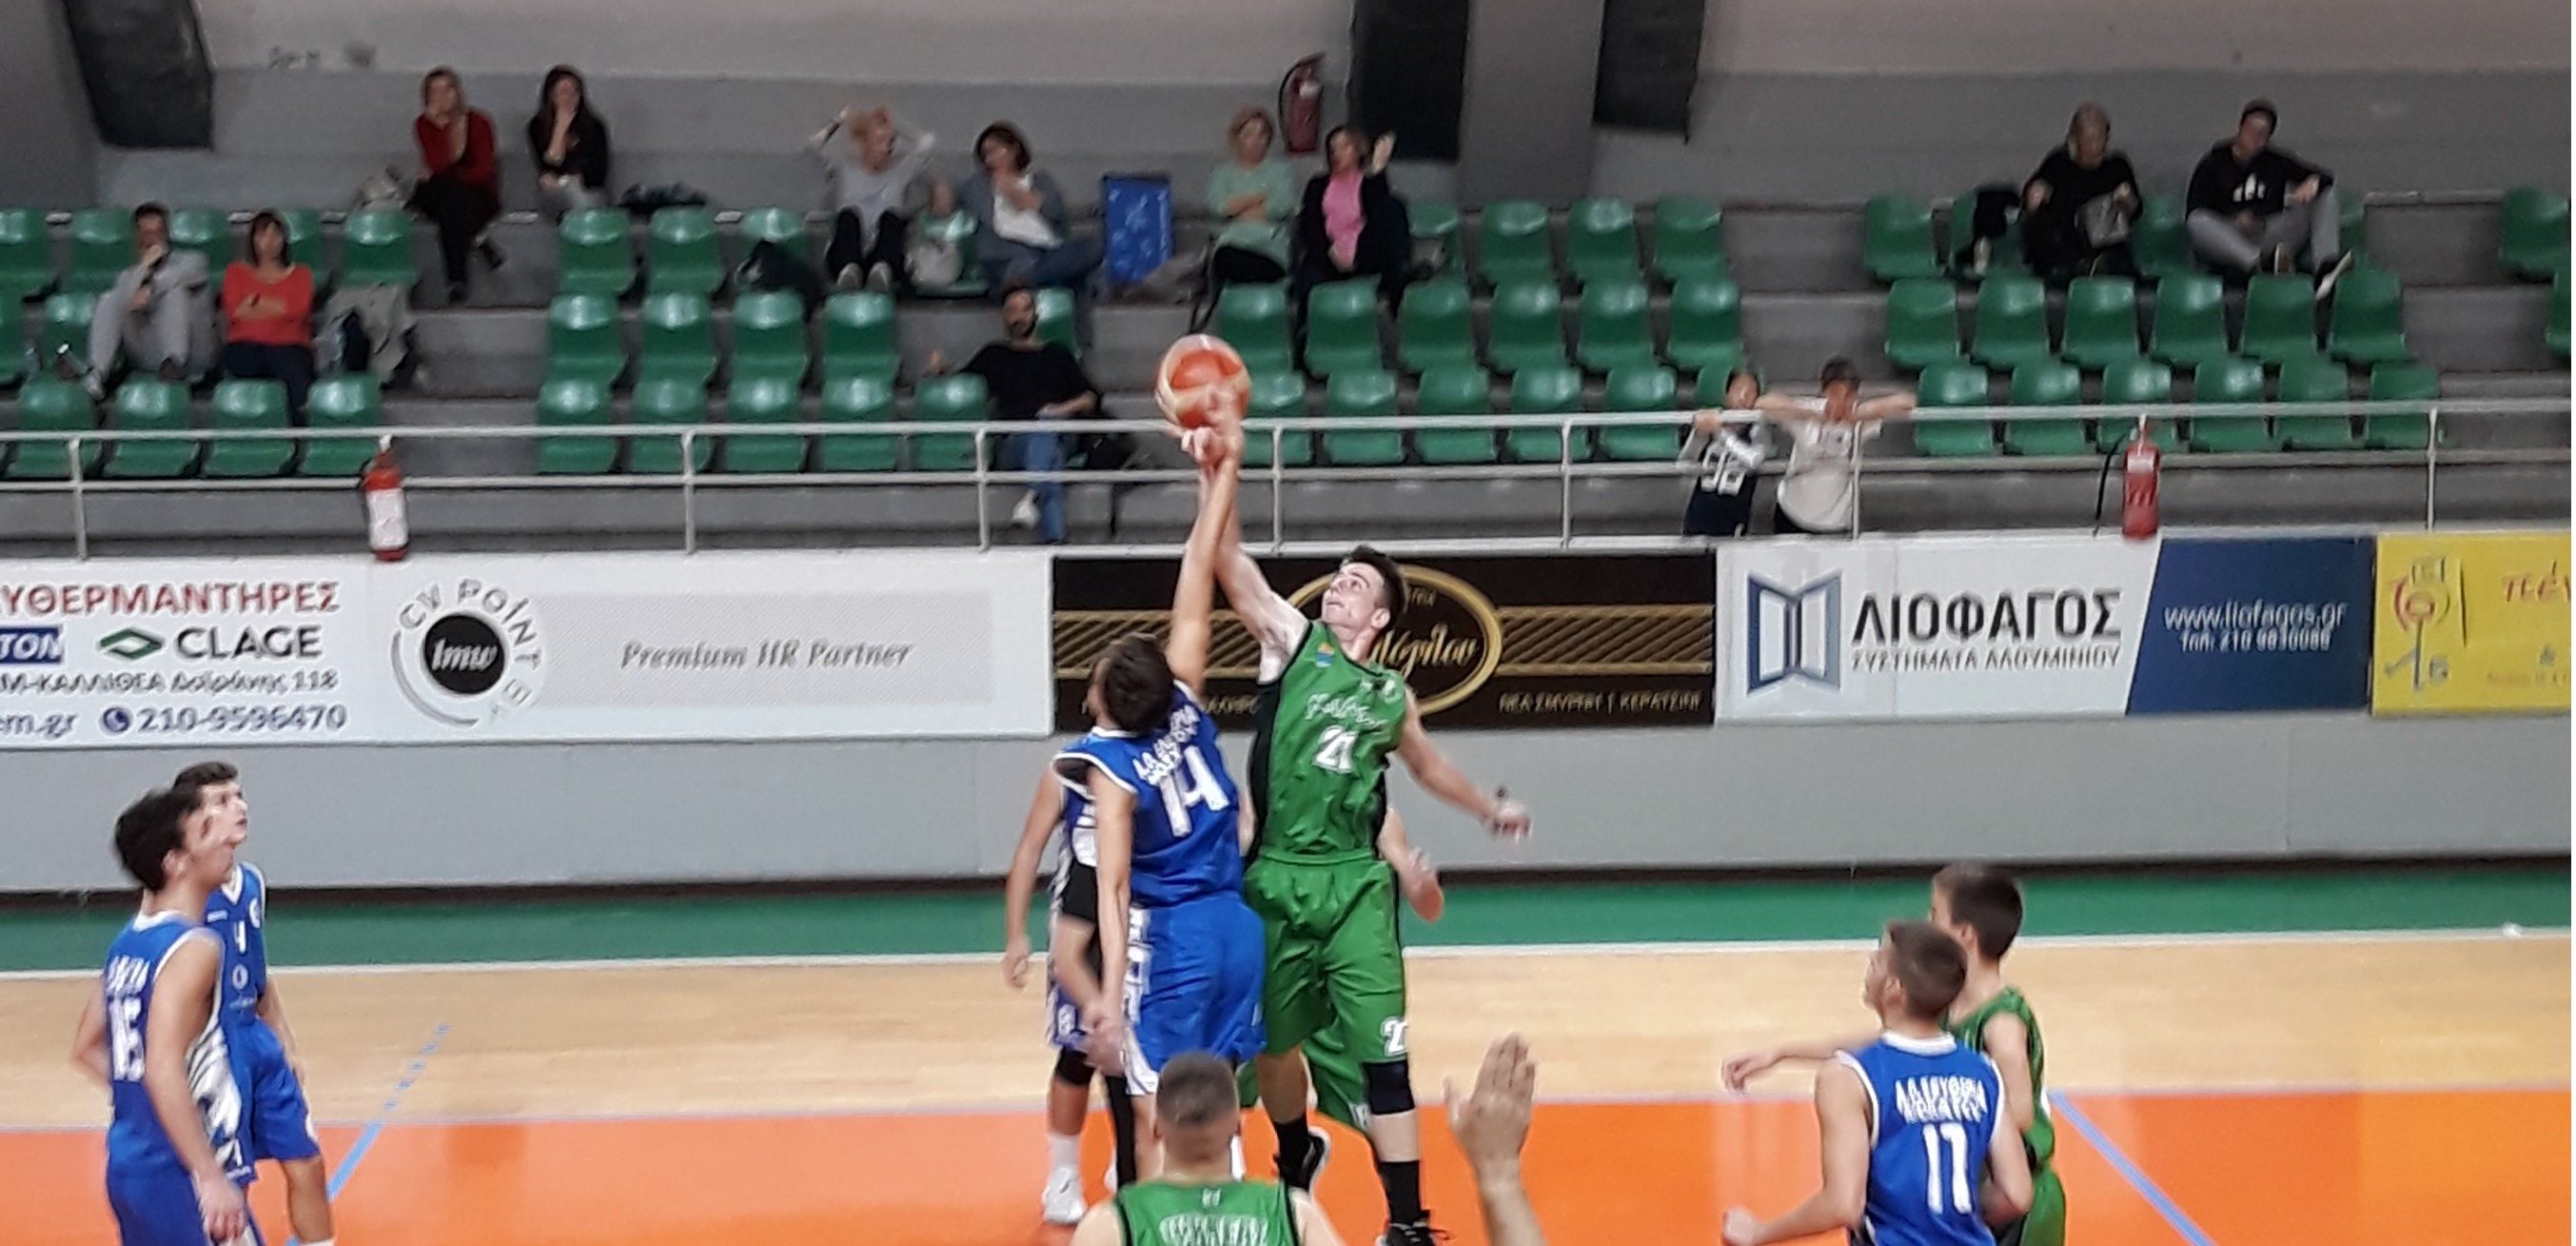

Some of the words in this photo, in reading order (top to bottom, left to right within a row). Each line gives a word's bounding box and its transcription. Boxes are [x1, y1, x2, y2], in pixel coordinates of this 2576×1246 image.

[1852, 591, 2121, 644] ΛΙΟΦΑΓΟΣ
[175, 624, 324, 660] CLAGE
[621, 642, 747, 669] Premium
[757, 639, 799, 666] HR
[809, 639, 915, 666] Partner
[1852, 648, 1977, 672] ΣΥΣΤΗΜΑΤΑ
[1984, 645, 2120, 670] ΑΛΟΥΜΙΝΙΟΥ
[293, 668, 339, 691] 118
